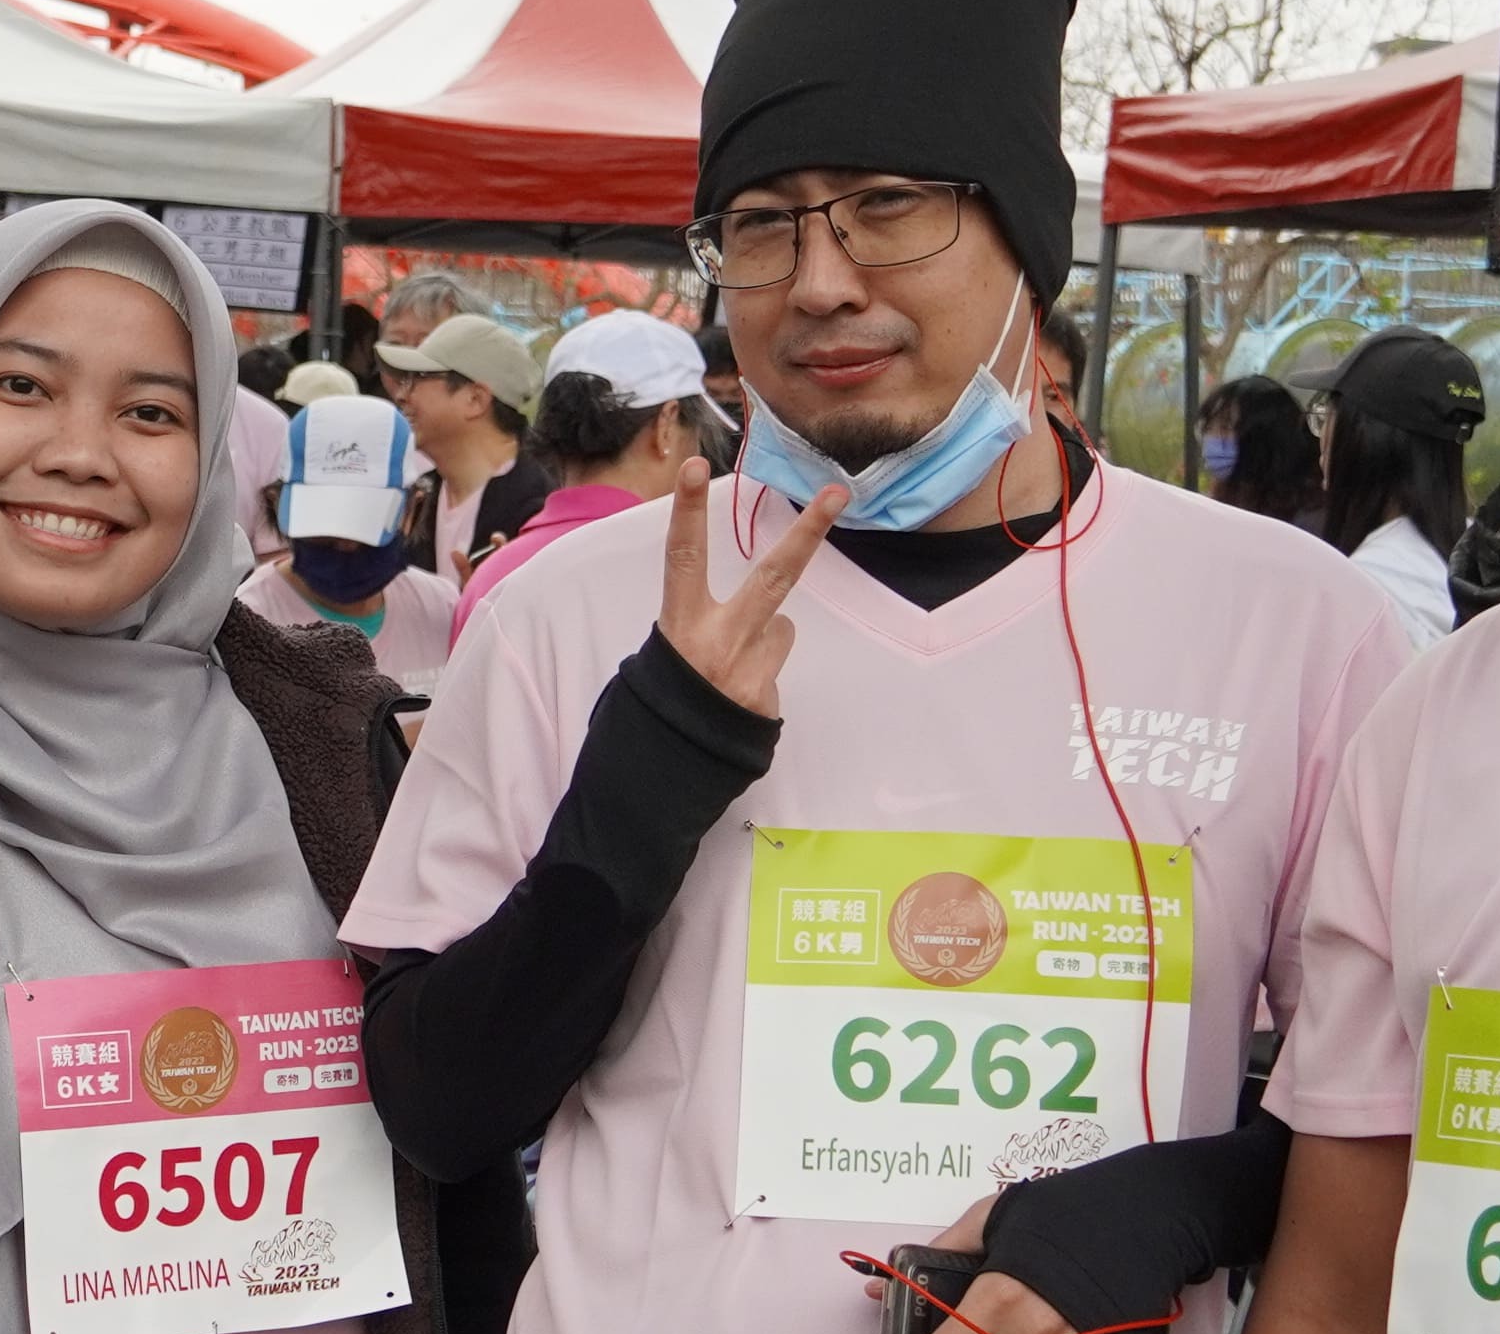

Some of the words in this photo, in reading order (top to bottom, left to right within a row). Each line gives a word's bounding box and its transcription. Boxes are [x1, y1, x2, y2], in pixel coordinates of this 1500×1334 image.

[1068, 702, 1248, 752] TAIWAN
[1067, 735, 1239, 802] TECH
[791, 897, 867, 924] 競賽組
[1011, 890, 1110, 914] TAIWAN
[793, 930, 864, 956] 6K男
[913, 934, 954, 945] TAIWAN
[955, 936, 981, 946] TECH
[1032, 920, 1087, 942] RUN
[1103, 923, 1164, 946] 2023
[1052, 958, 1080, 972] 寄物
[238, 1011, 319, 1034] TAIWAN
[51, 1040, 121, 1067] 競賽組
[259, 1039, 304, 1061] RUN
[315, 1035, 359, 1056] 2023
[160, 1067, 194, 1078] TAIWAN
[195, 1065, 217, 1076] TECH
[276, 1073, 300, 1087] 寄物
[320, 1068, 354, 1083] 完賽禮
[832, 1016, 1098, 1114] 6262
[56, 1071, 120, 1099] 6K女
[801, 1138, 929, 1184] Erfansyah
[938, 1142, 972, 1179] Ali
[98, 1136, 321, 1233] 6507
[62, 1269, 117, 1305] LINA
[121, 1257, 231, 1298] MARLINA
[274, 1263, 320, 1280] 2023
[246, 1280, 302, 1298] TAIWAN
[305, 1277, 340, 1292] TECH
[914, 1274, 929, 1317] POO
